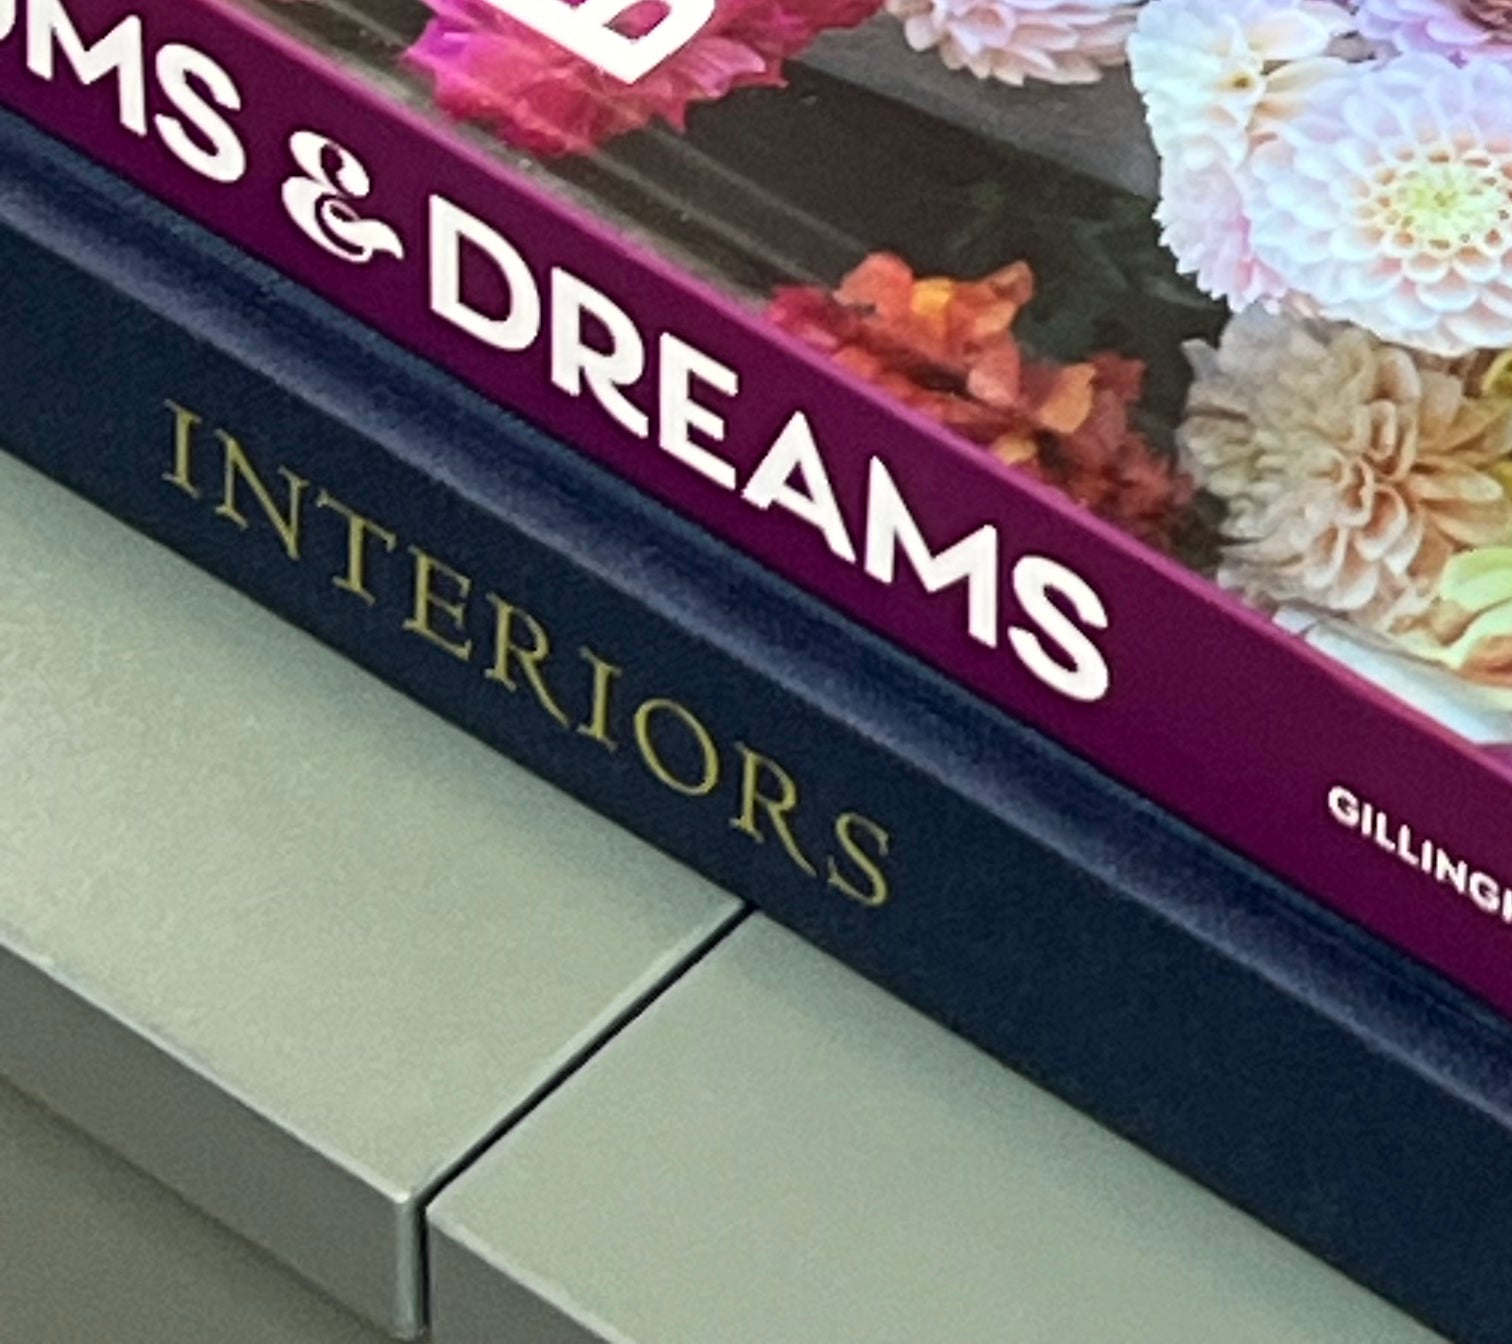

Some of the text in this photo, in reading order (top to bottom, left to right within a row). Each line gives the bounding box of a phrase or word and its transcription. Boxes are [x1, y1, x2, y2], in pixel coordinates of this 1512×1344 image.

[162, 400, 893, 907] INTERIORS
[281, 131, 404, 263] &
[428, 193, 1110, 700] DREAMS
